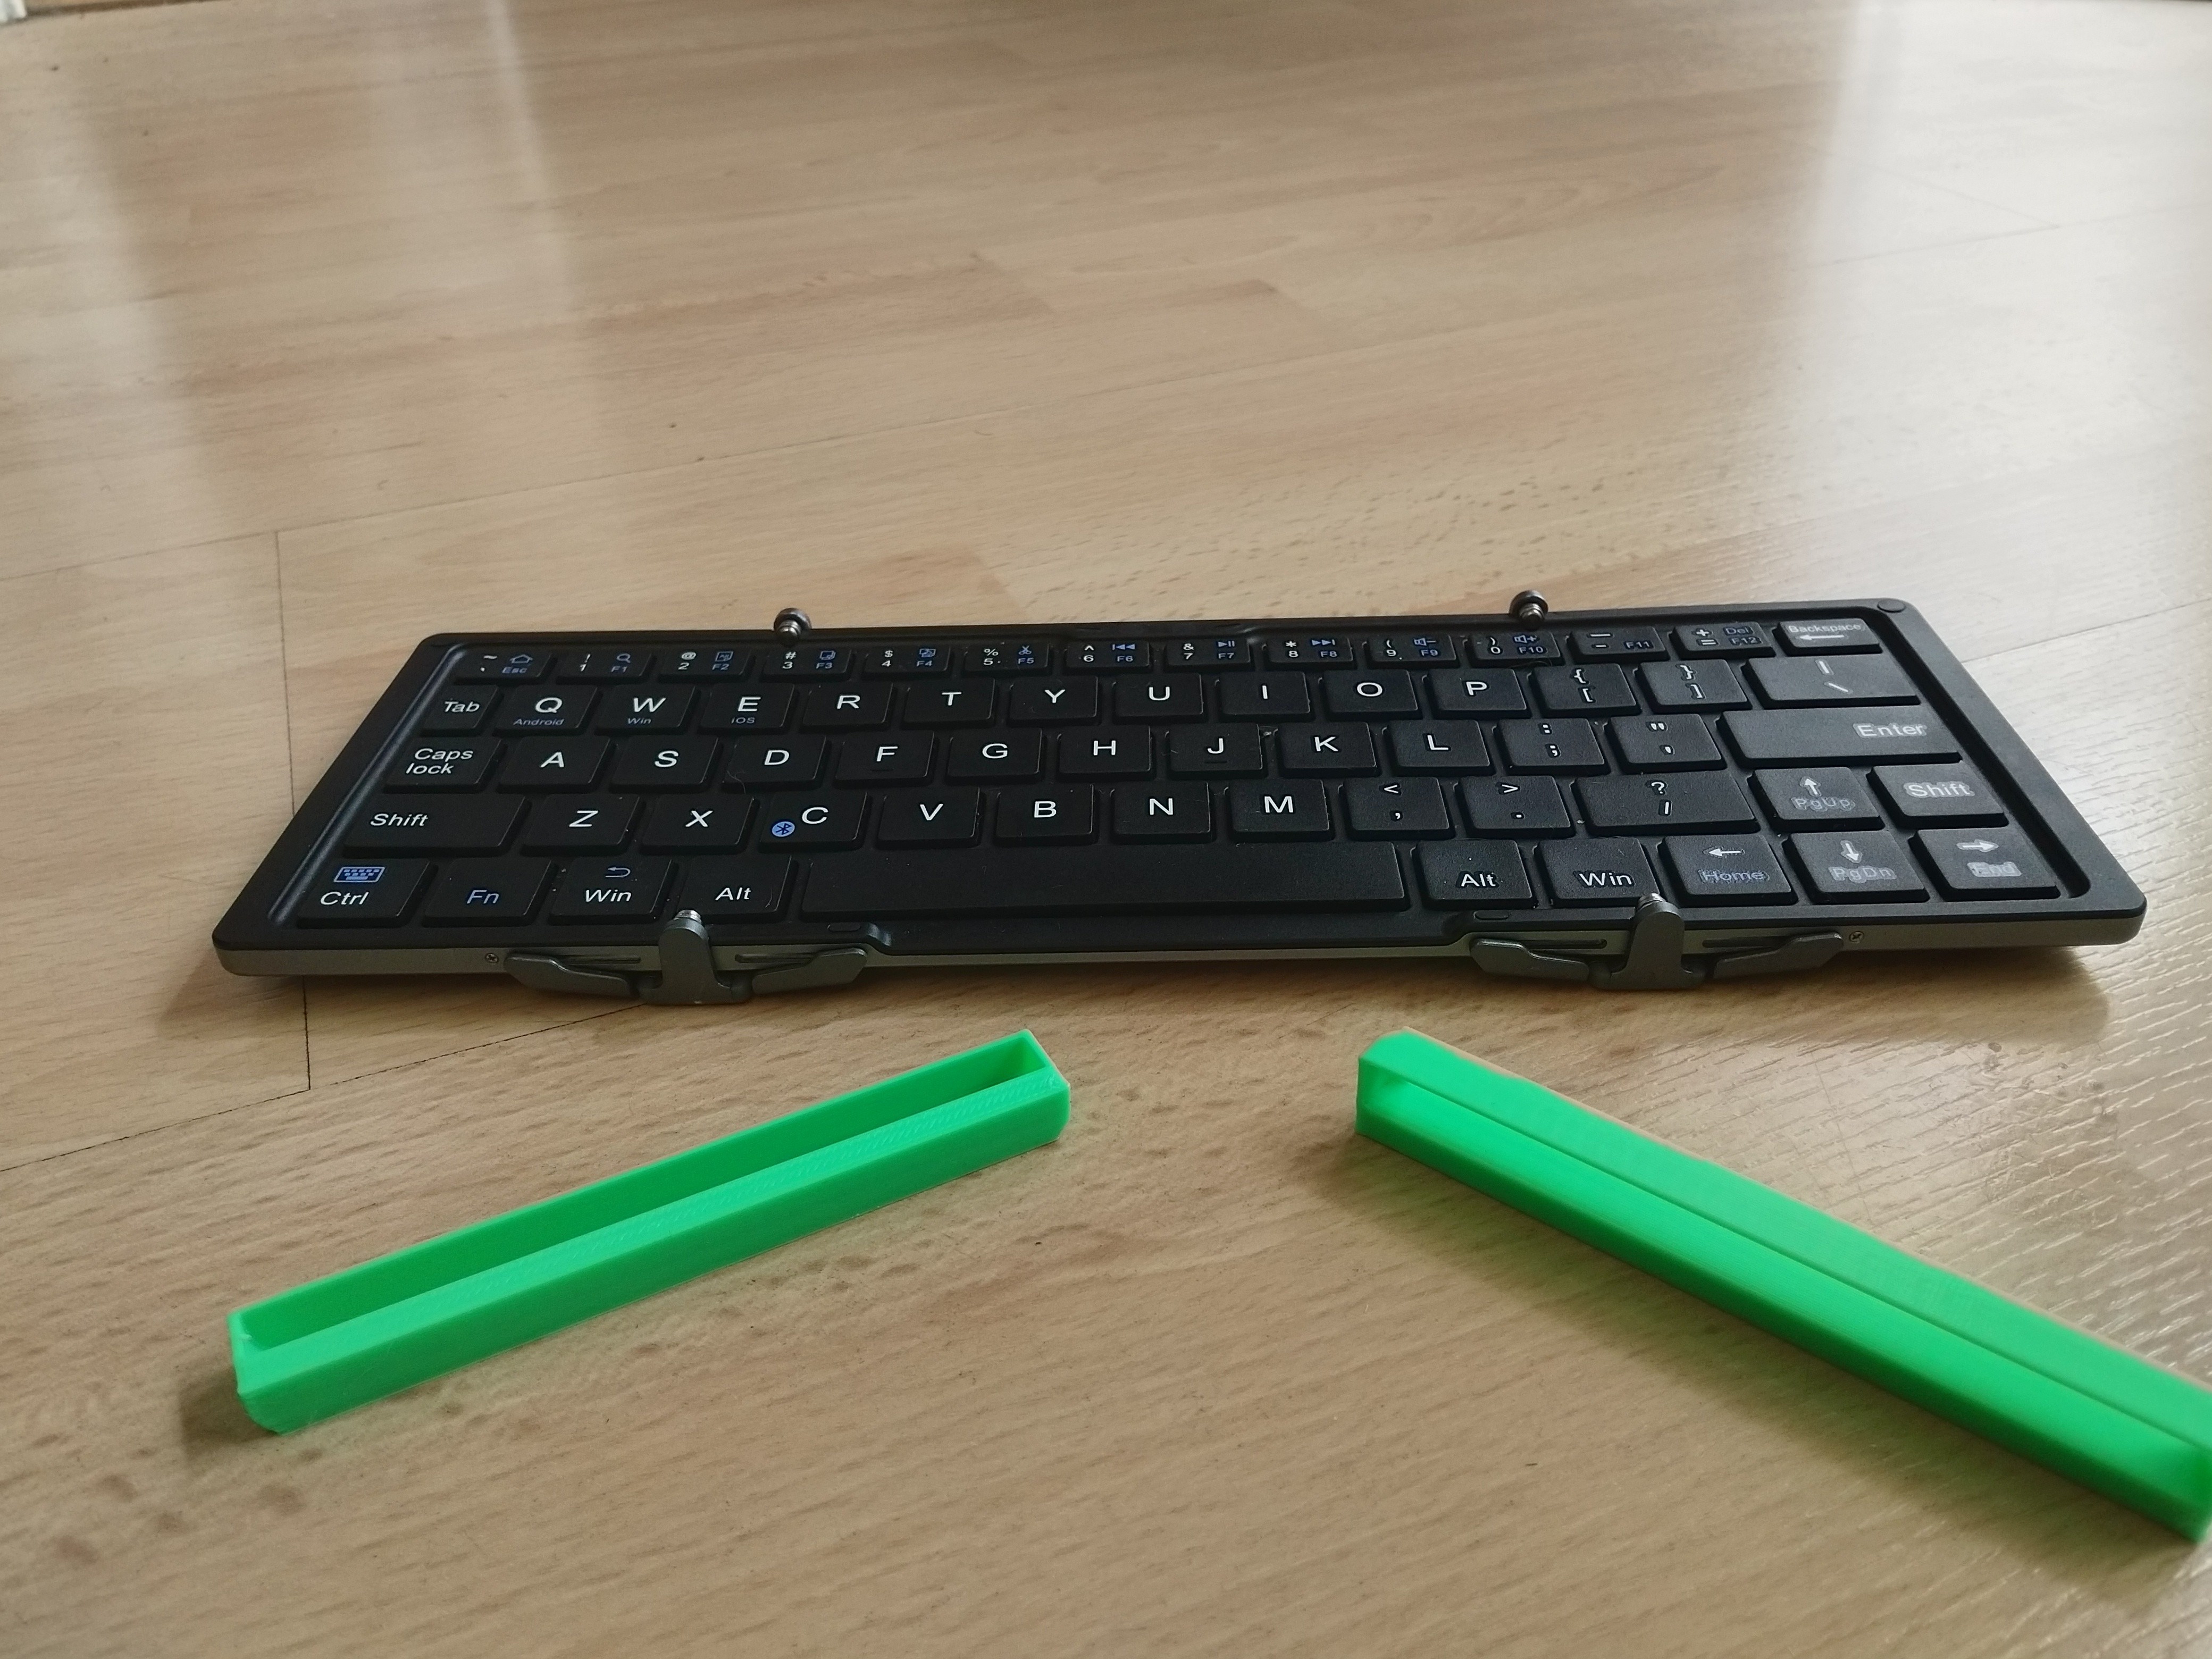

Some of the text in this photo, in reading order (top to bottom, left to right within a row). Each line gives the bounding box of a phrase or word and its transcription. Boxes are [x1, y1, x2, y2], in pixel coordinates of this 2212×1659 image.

[1726, 626, 1750, 634] Del
[1788, 625, 1861, 634] Backspace
[1386, 640, 1392, 648] (
[1490, 637, 1496, 646] )
[1731, 635, 1755, 644] F12
[585, 653, 591, 663] !
[1574, 669, 1586, 684] {
[1680, 665, 1693, 680] }
[1149, 686, 1170, 701] U
[1262, 685, 1268, 699] I
[1356, 682, 1382, 697] O
[1466, 681, 1487, 696] P
[1582, 688, 1593, 702] [
[1690, 684, 1703, 698] ]
[836, 695, 860, 709] R
[942, 692, 962, 706] T
[1044, 689, 1066, 703] Y
[445, 701, 480, 713] Tab
[535, 697, 563, 713] Q
[633, 698, 666, 713] W
[738, 697, 761, 711] E
[1543, 724, 1551, 733] :
[1857, 725, 1923, 737] Enter
[1093, 740, 1116, 756] H
[1207, 738, 1224, 754] J
[1314, 736, 1338, 752] K
[1427, 735, 1449, 750] L
[414, 748, 473, 763] Caps
[764, 750, 790, 765] D
[876, 746, 898, 762] F
[982, 743, 1008, 759] G
[1549, 745, 1558, 756] ;
[540, 752, 564, 768] A
[655, 750, 678, 768] S
[406, 763, 454, 774] lock
[1384, 784, 1399, 794] <
[1502, 784, 1518, 793] >
[1651, 782, 1665, 794] ?
[1909, 784, 1971, 796] Shift
[1034, 801, 1057, 818] B
[1149, 798, 1174, 815] N
[1264, 795, 1294, 813] M
[1795, 798, 1850, 810] PgUp
[569, 810, 599, 827] Z
[685, 810, 713, 827] X
[801, 807, 828, 824] C
[919, 803, 944, 821] V
[370, 813, 429, 826] Shift
[1461, 872, 1496, 887] Alt
[1579, 873, 1634, 886] Win
[1703, 869, 1764, 880] Home
[1832, 867, 1893, 880] PgDn
[320, 891, 369, 905] Ctrl
[466, 890, 499, 904] Fn
[585, 889, 632, 902] Win
[715, 887, 751, 901] Alt
